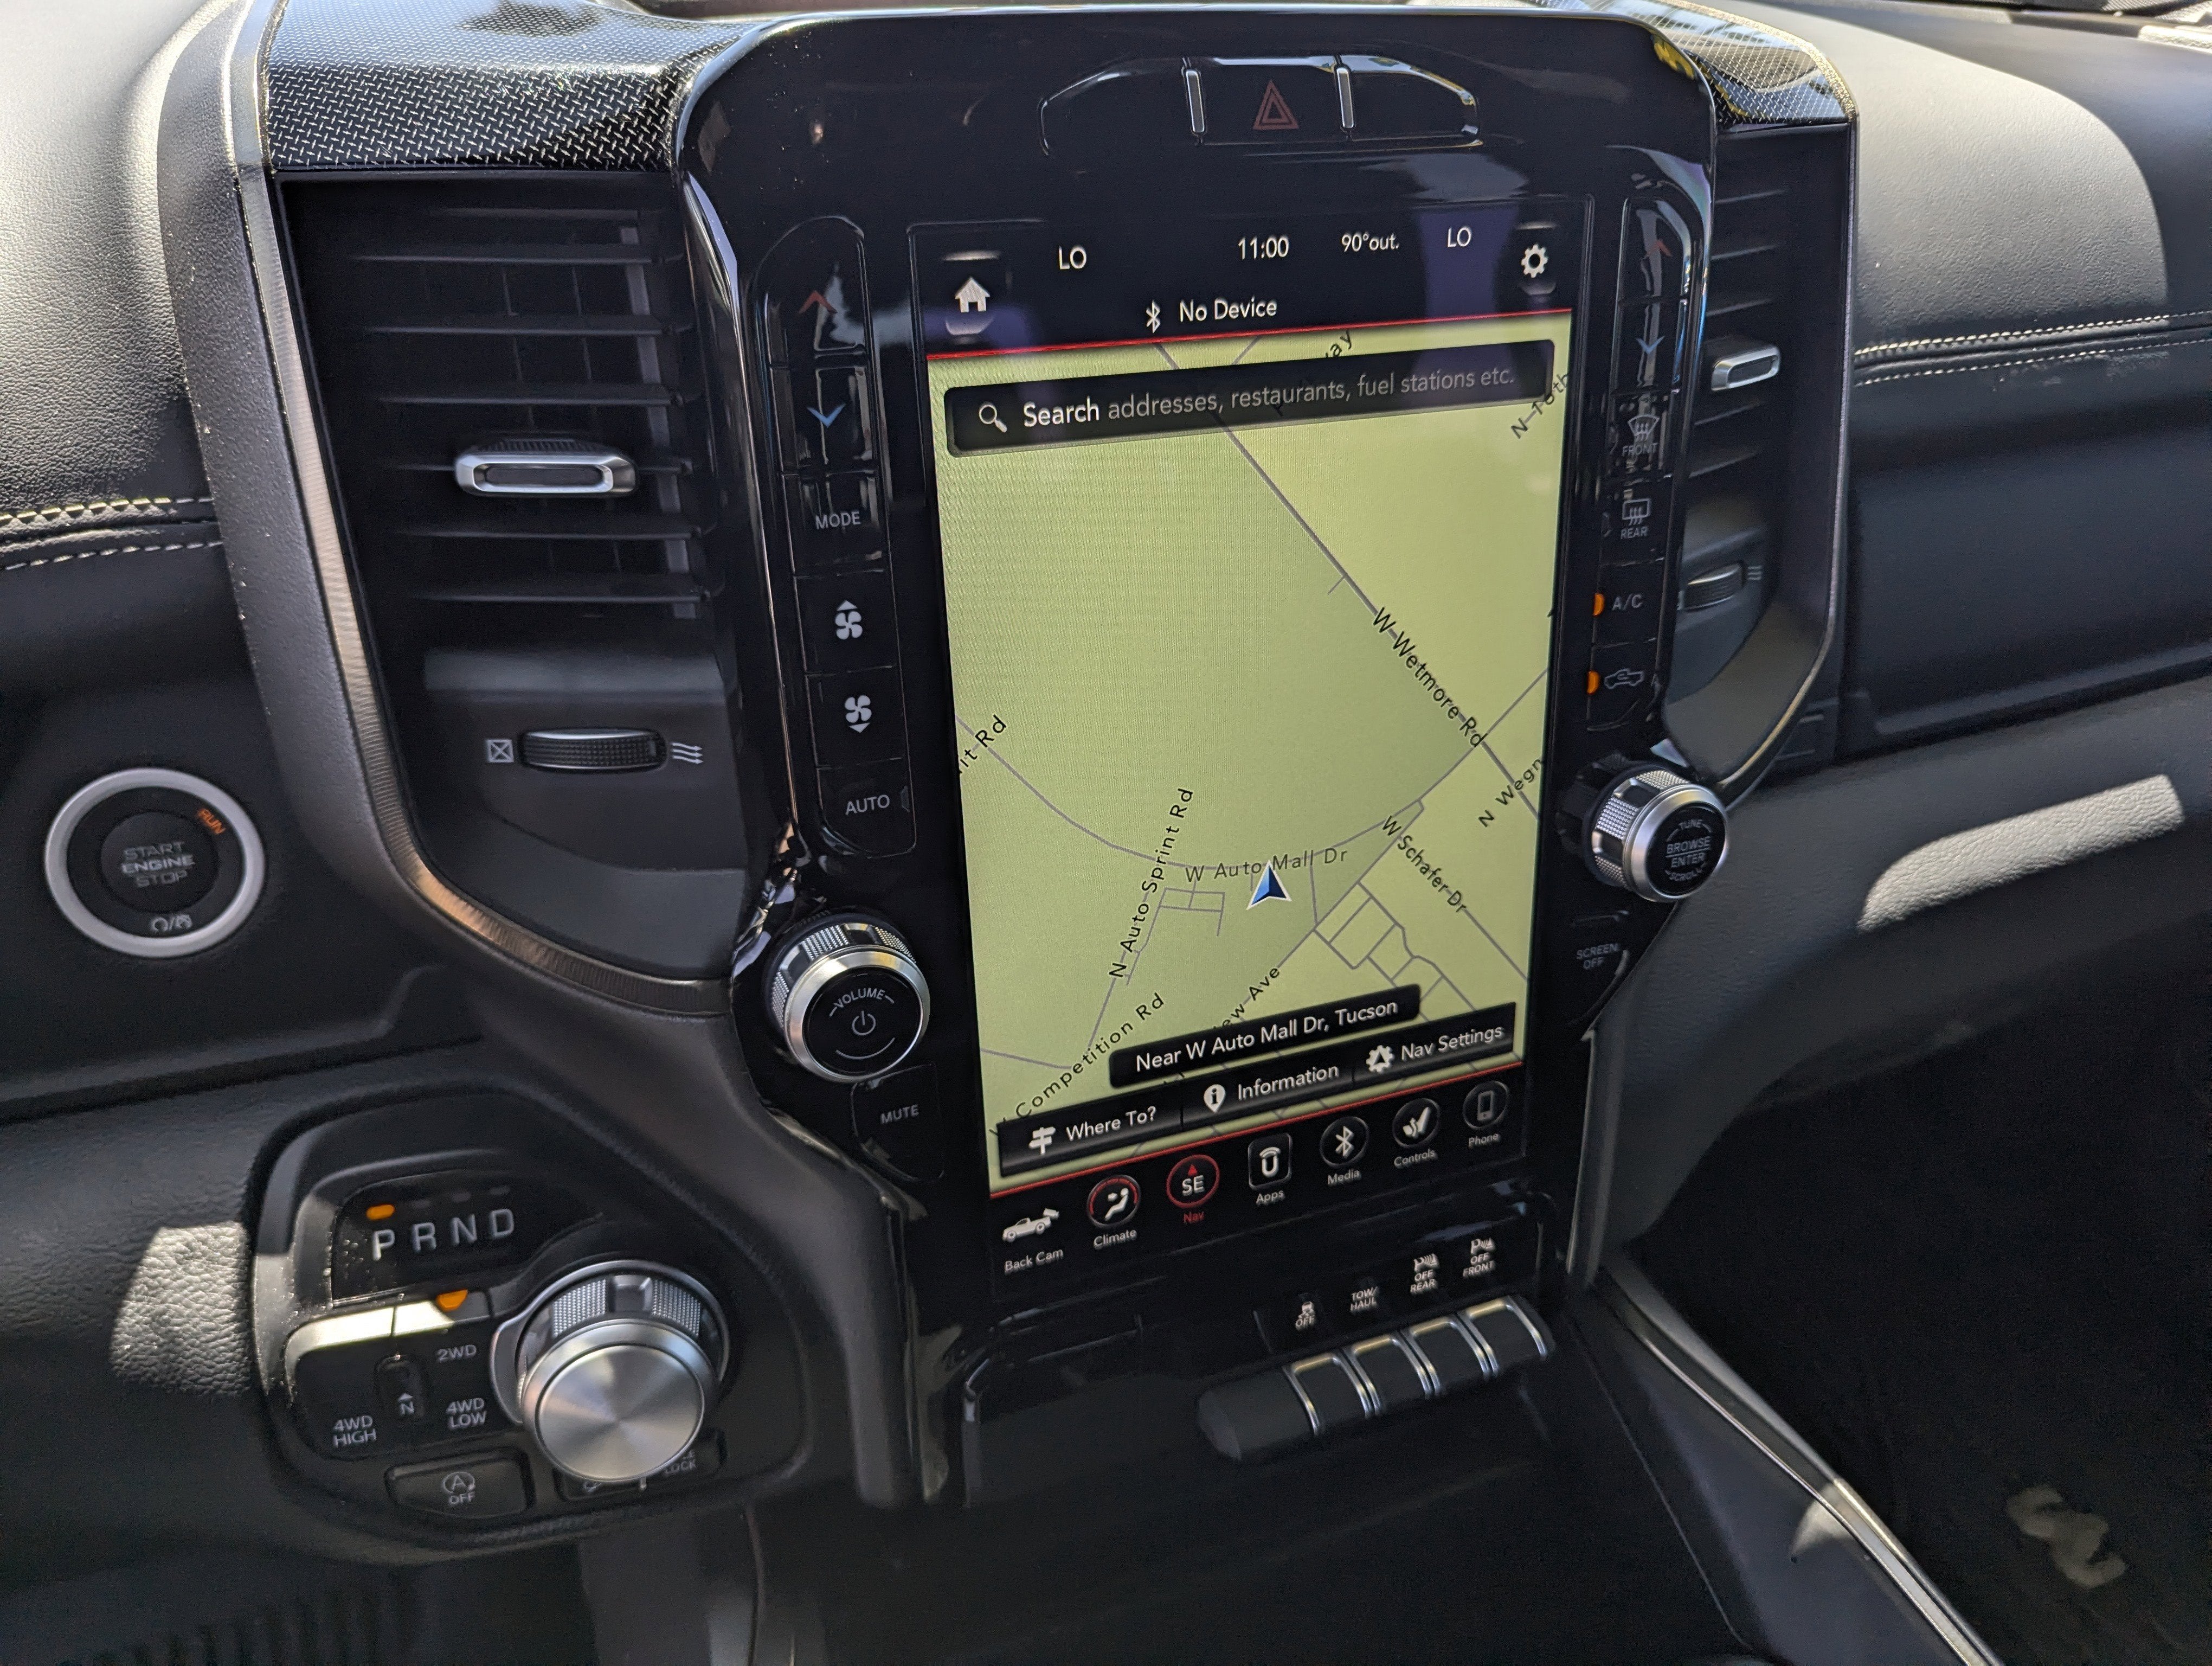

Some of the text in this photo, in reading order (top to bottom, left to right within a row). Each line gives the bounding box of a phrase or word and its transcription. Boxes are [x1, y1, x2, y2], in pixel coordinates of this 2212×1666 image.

[1447, 225, 1472, 248] LO
[1058, 245, 1087, 270] LO
[1238, 235, 1289, 261] 11:00
[1179, 296, 1278, 323] No Device
[1023, 396, 1100, 428] Search
[1108, 392, 1224, 420] addresses,
[1231, 381, 1351, 411] restaurants,
[1357, 371, 1394, 398] fuel
[1401, 369, 1475, 393] stations
[1481, 367, 1516, 387] etc.
[1511, 417, 1528, 439] N
[1622, 443, 1658, 457] FRONT
[815, 510, 861, 530] MODE
[1620, 527, 1648, 540] REAR
[1611, 593, 1643, 611] A/C
[1373, 606, 1488, 748] W Wetmore Rd
[975, 714, 1007, 748] Rd
[845, 794, 891, 815] AUTO
[197, 808, 227, 835] RUN
[1477, 809, 1495, 828] N
[1679, 818, 1703, 831] TUNE
[123, 841, 185, 861] START
[1666, 836, 1712, 854] BROWSE
[120, 854, 196, 874] ENGINE
[1185, 847, 1348, 882] W Auto Mall Dr
[1382, 815, 1467, 913] W Schafer Dr
[1670, 852, 1707, 868] ENTER
[136, 870, 188, 888] STOP
[1109, 787, 1193, 978] N Auto Sprint Rd
[1669, 867, 1702, 881] SCROLL
[1576, 943, 1620, 960] SCREEN
[1583, 957, 1604, 970] OFF
[1249, 967, 1280, 1001] Ave
[834, 987, 886, 1009] VOLUME
[1136, 999, 1399, 1072] Near W Auto Mall Dr, Tucson
[1401, 1024, 1505, 1062] Nav Settings
[1015, 992, 1165, 1119] Competition Rd
[1237, 1064, 1340, 1101] Information
[880, 1104, 919, 1125] MUTE
[1066, 1106, 1156, 1142] Where To?
[1468, 1131, 1501, 1148] Phone
[1393, 1148, 1438, 1168] Controls
[1181, 1175, 1205, 1196] SE
[1327, 1168, 1361, 1186] Media
[1256, 1189, 1284, 1206] Apps
[1182, 1210, 1205, 1225] Nav
[372, 1207, 515, 1261] P R N D
[1093, 1228, 1138, 1251] Climate
[1004, 1248, 1064, 1275] Back Cam
[1462, 1260, 1496, 1278] FRONT
[1470, 1252, 1491, 1266] OFF
[1410, 1278, 1438, 1294] REAR
[1414, 1269, 1435, 1283] OFF
[1350, 1297, 1378, 1313] HAUL
[1295, 1314, 1316, 1331] OFF
[437, 1343, 477, 1363] 2WD
[400, 1400, 415, 1415] N
[446, 1396, 485, 1415] 4WD
[333, 1414, 373, 1433] 4WD
[447, 1409, 487, 1430] LOW
[333, 1427, 377, 1447] HIGH
[447, 1490, 477, 1506] OFF
